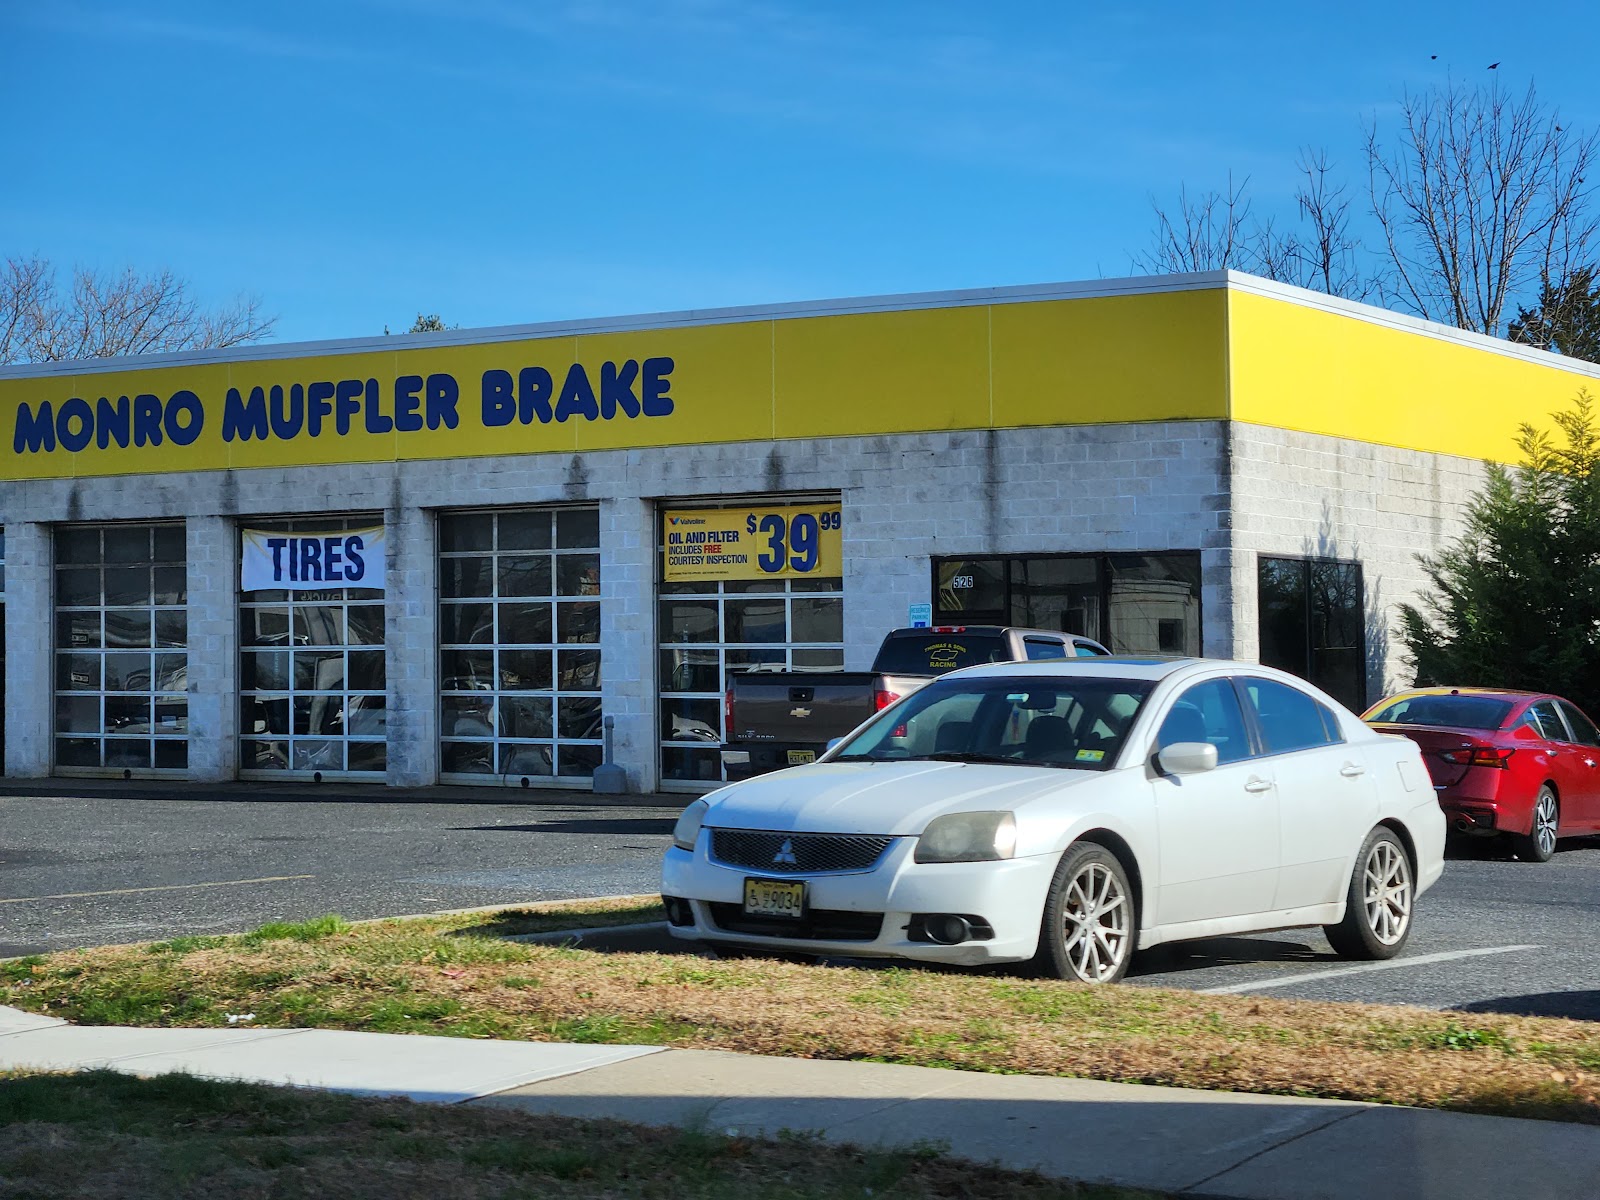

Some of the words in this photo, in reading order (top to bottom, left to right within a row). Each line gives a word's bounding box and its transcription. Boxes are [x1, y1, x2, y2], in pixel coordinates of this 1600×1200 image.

[13, 390, 204, 454] MONRO
[222, 373, 459, 443] MUFFLER
[481, 356, 675, 427] BRAKE
[680, 517, 706, 525] Valvoline
[669, 532, 684, 545] OIL
[685, 531, 706, 544] AND
[707, 530, 740, 543] FILTER
[669, 545, 702, 555] INCLUDES
[703, 544, 722, 554] FREE
[267, 535, 365, 582] TIRES
[669, 555, 705, 565] COURTESY
[706, 554, 748, 565] INSPECTION
[953, 576, 973, 588] 526
[924, 643, 947, 652] THOMAS
[953, 643, 967, 653] SONS
